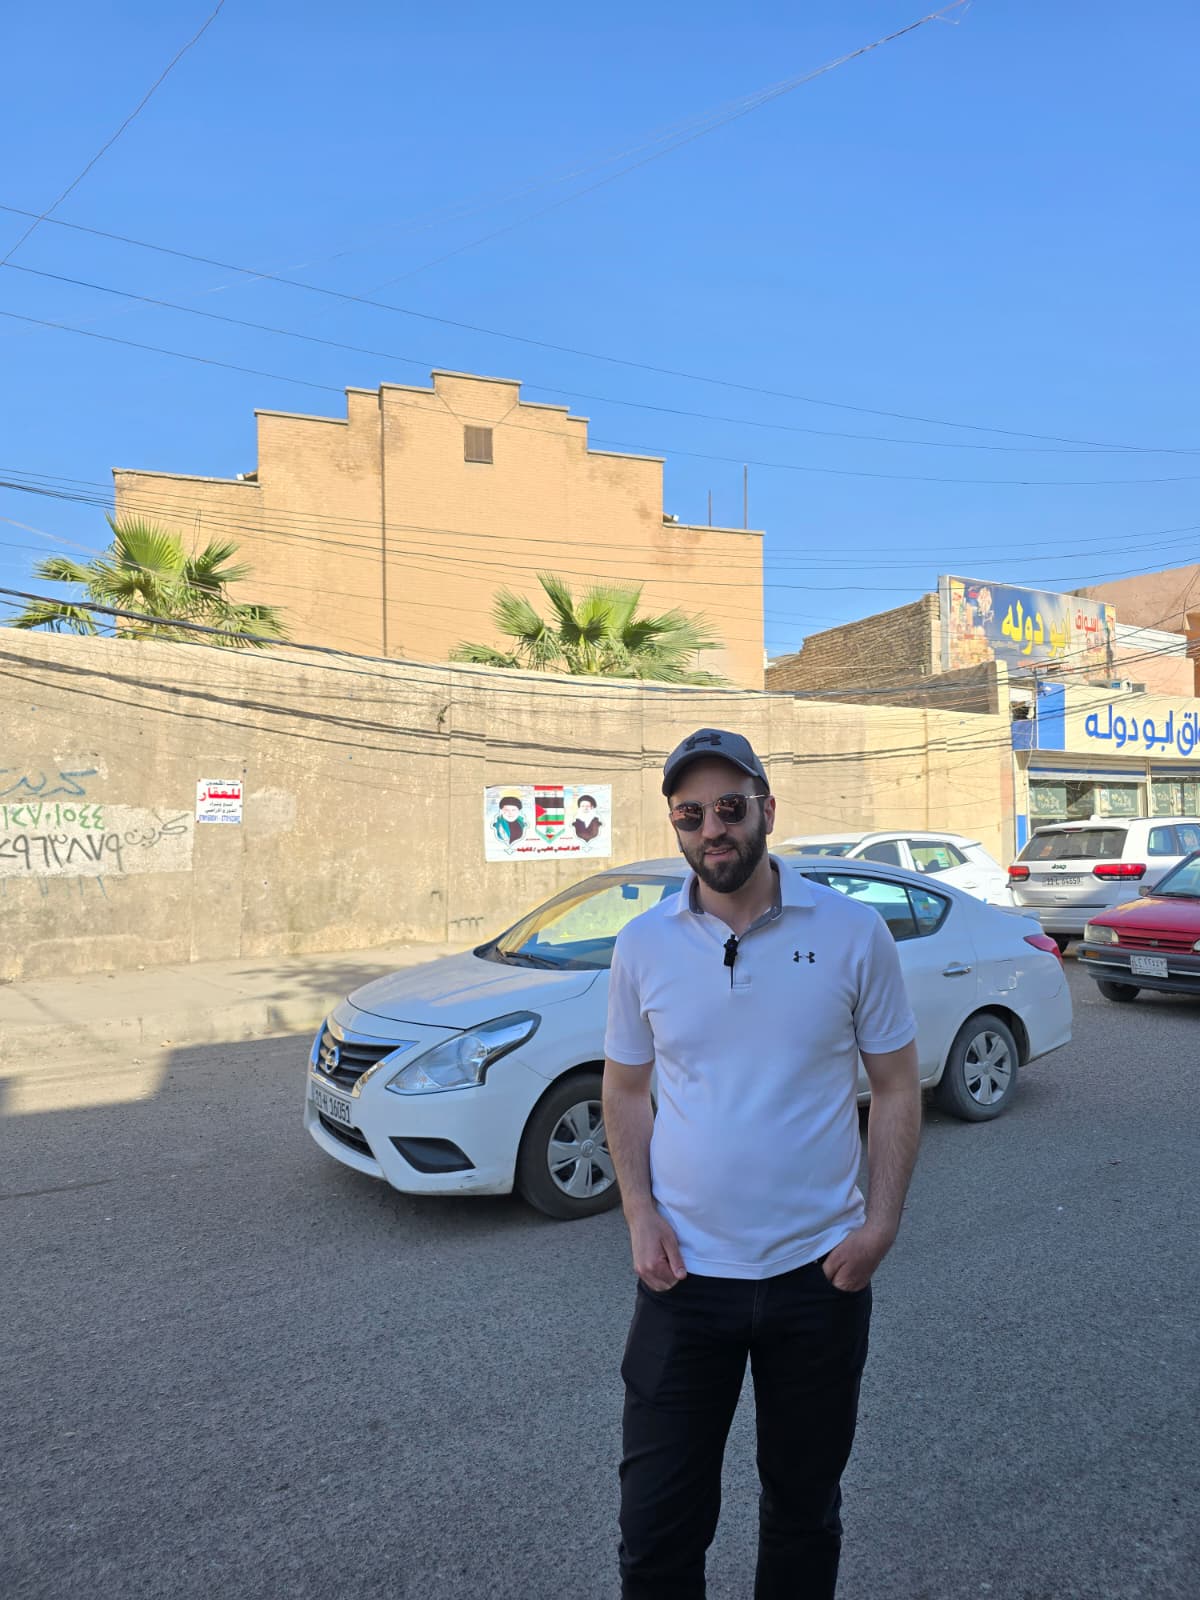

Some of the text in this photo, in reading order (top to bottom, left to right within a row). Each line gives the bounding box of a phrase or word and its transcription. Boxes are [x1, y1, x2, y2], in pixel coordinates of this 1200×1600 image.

[1001, 599, 1044, 656] دوله
[1047, 608, 1071, 658] ابو
[1085, 704, 1200, 757] اق ابو دوله
[198, 787, 241, 802] للعقار
